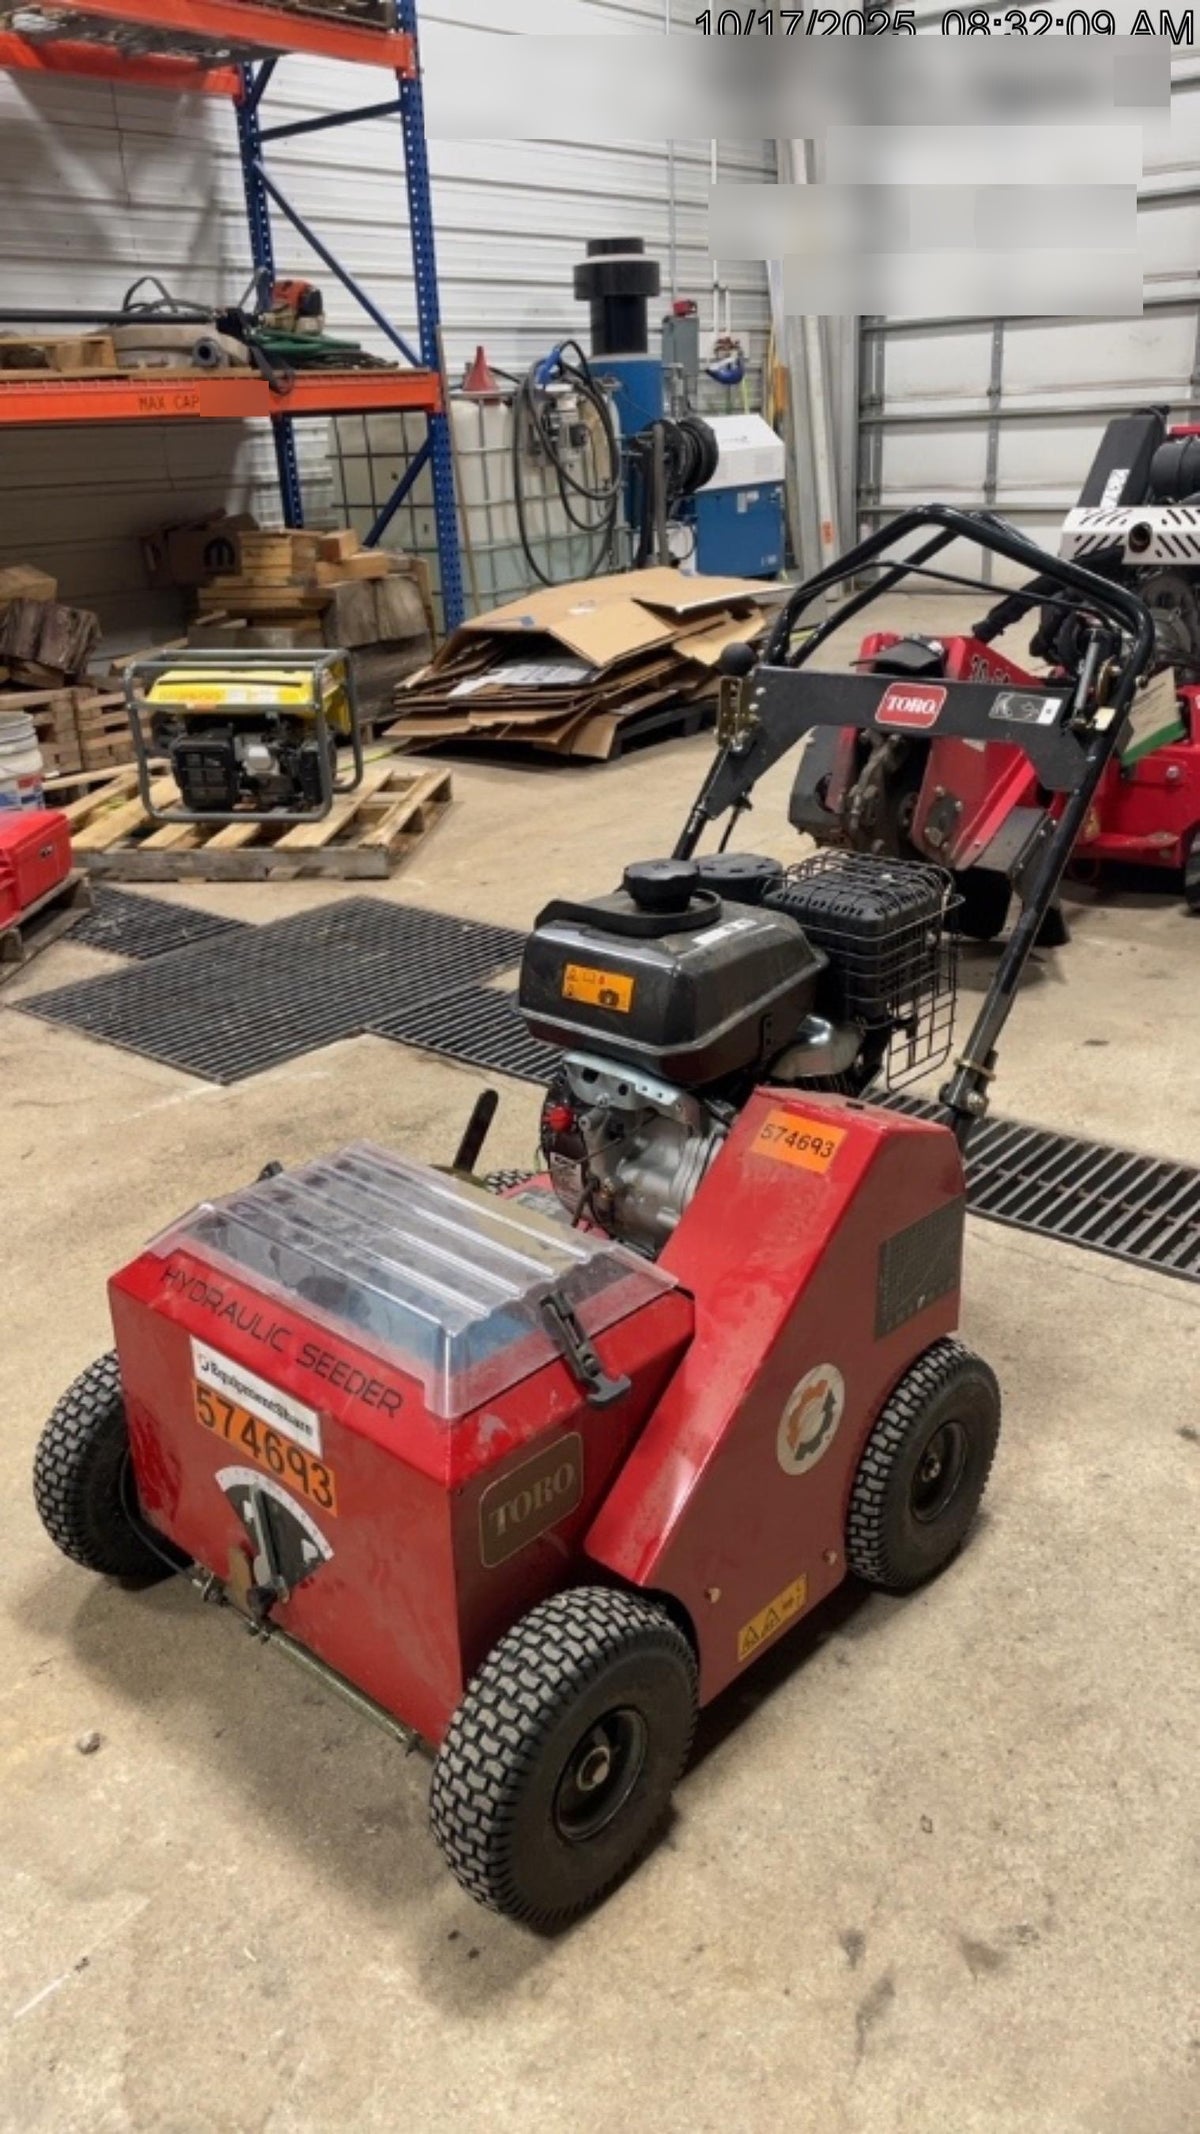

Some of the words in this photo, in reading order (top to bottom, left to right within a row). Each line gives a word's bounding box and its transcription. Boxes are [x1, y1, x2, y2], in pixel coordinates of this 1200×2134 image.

[139, 396, 166, 411] MAX
[886, 694, 935, 715] TORO
[760, 1122, 836, 1159] 574693
[159, 1265, 293, 1353] HYDRAULIC
[295, 1342, 405, 1419] SEEDER
[208, 1360, 315, 1437] EquipmentShare
[196, 1382, 334, 1509] 574693
[487, 1461, 576, 1538] TORO
